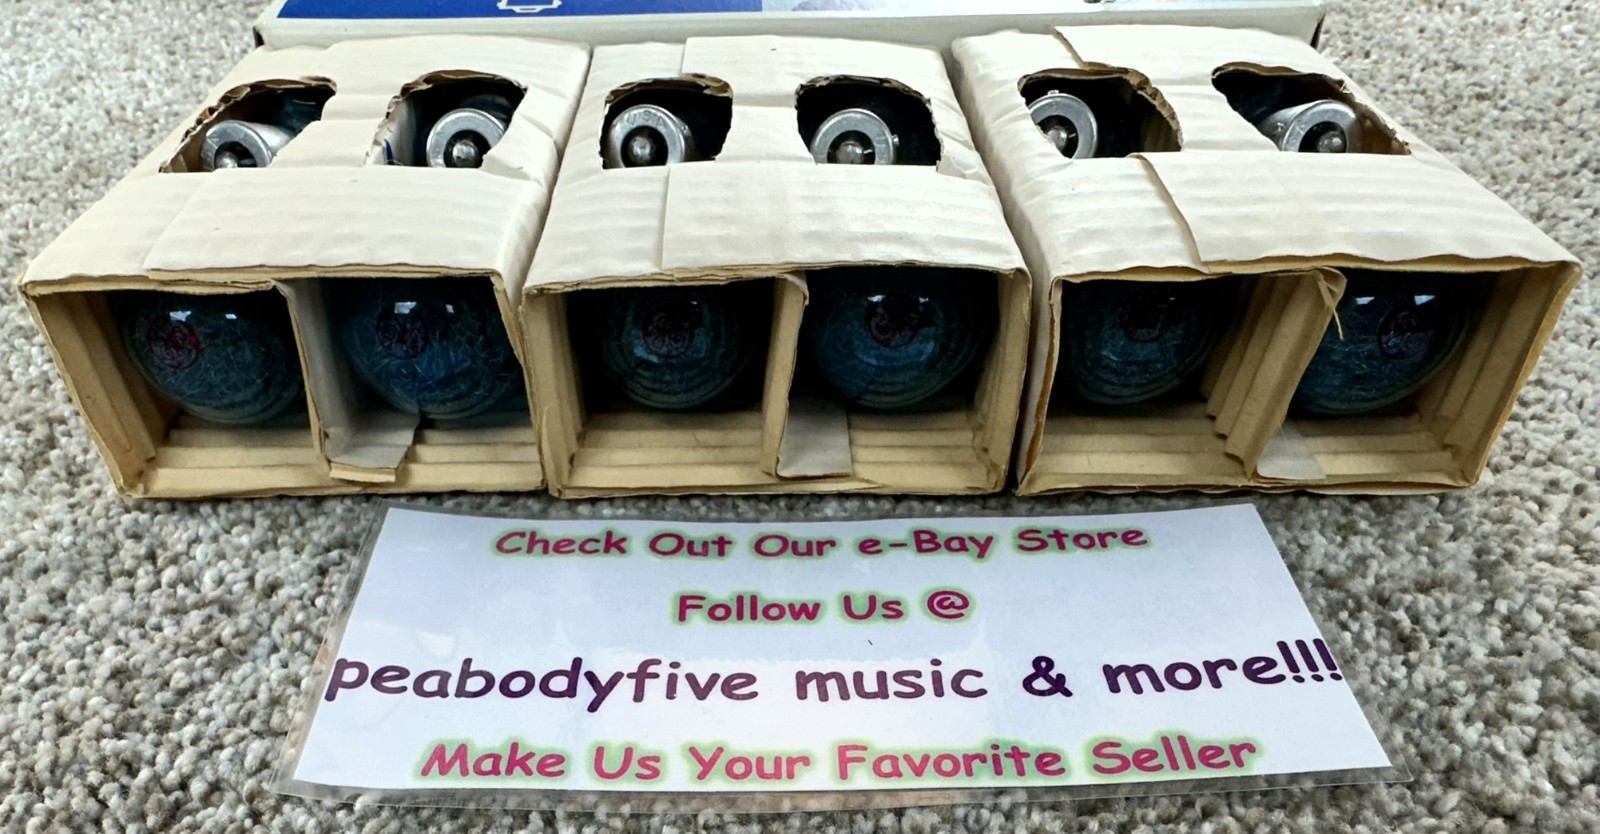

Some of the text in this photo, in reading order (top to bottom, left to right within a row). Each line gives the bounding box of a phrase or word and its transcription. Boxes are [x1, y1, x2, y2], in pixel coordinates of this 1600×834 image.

[495, 528, 1148, 559] Check Out Our e-Bay Store
[677, 590, 970, 623] Follow Us @
[324, 638, 1343, 713] peabodyfive music & more!!!
[420, 735, 1257, 781] Make Us Your Favorite Seller
